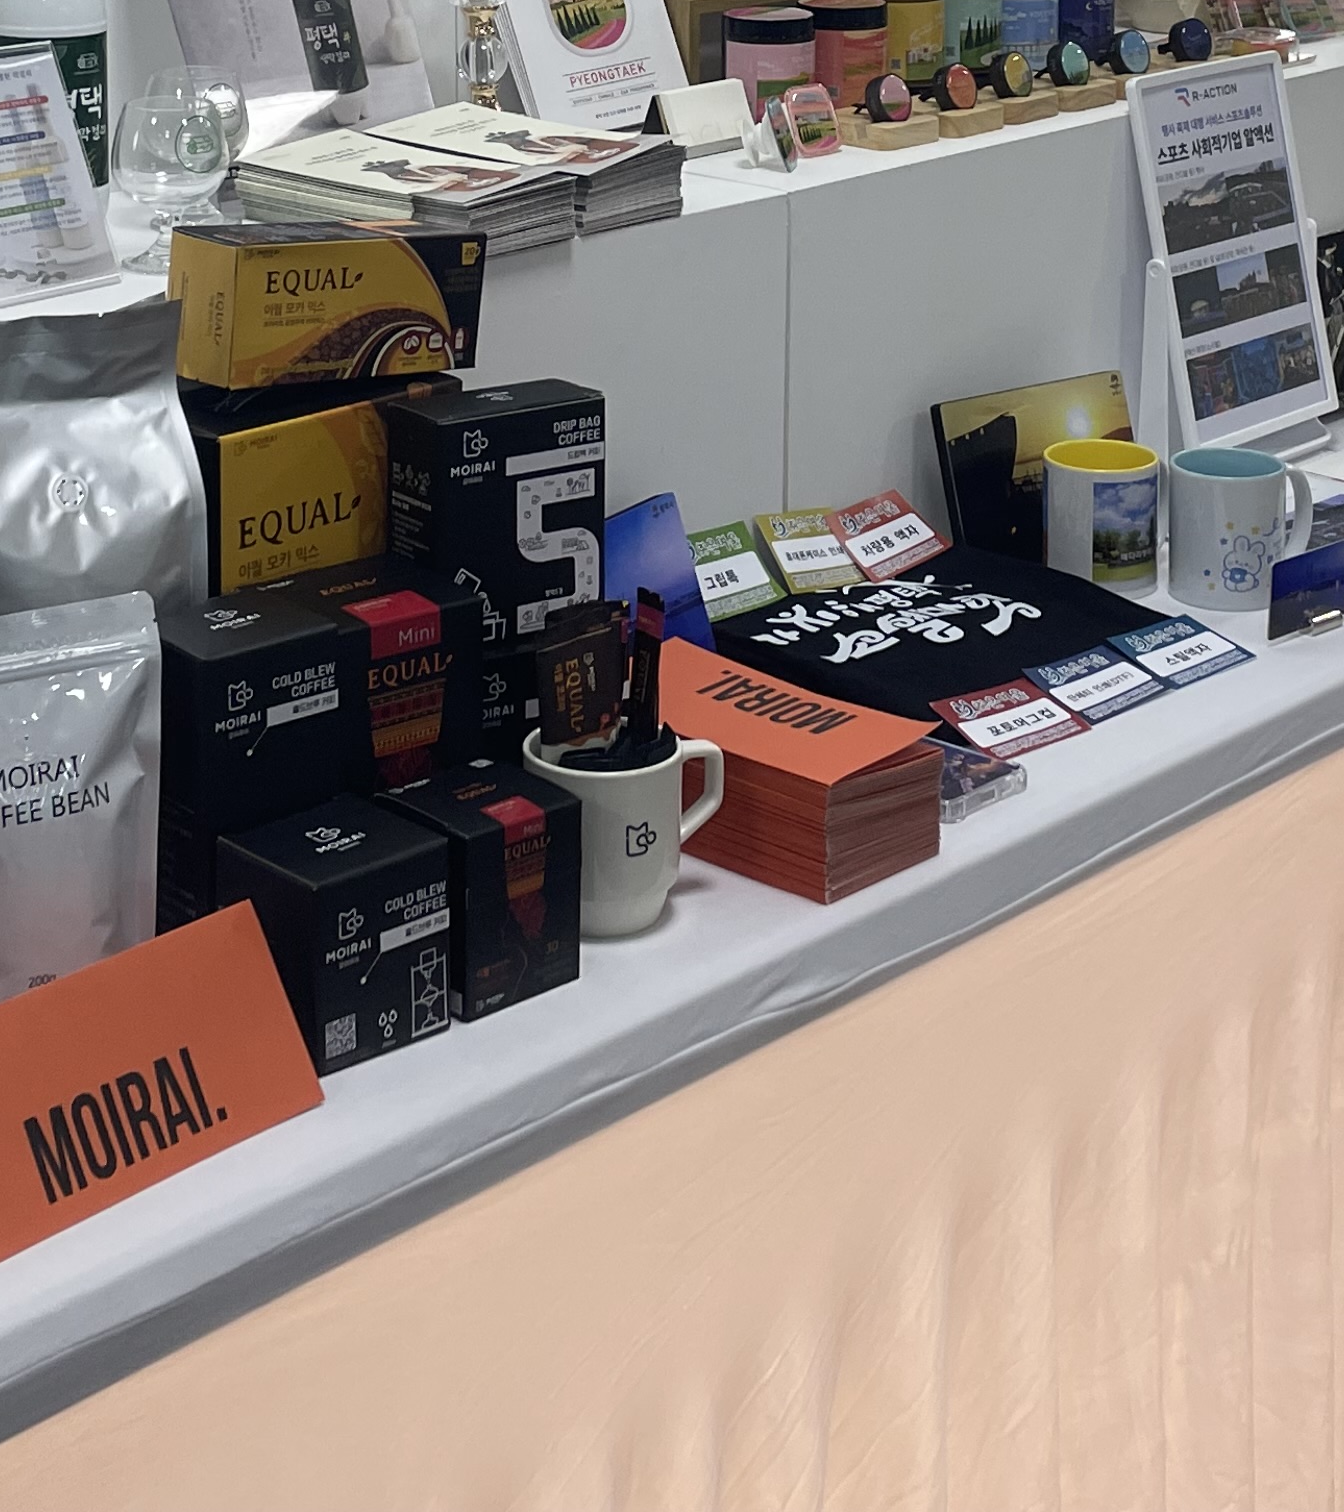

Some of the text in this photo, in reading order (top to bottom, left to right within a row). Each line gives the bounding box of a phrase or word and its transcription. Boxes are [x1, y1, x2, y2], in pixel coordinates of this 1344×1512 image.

[305, 23, 340, 50] 평택
[569, 61, 647, 88] PYEONGTAEK
[65, 83, 103, 119] 택
[1192, 83, 1237, 101] R-ACTION
[1191, 129, 1242, 158] 사회적기업
[266, 267, 355, 297] EQUAL
[553, 415, 601, 434] DRIP BAG
[558, 428, 601, 446] COFFEE
[450, 460, 495, 478] MOIRAI
[238, 492, 352, 549] EQUAL
[397, 624, 436, 648] Mini
[272, 661, 336, 690] COLD BLEW
[367, 651, 447, 689] EQUAL
[291, 675, 336, 698] COFFEE
[215, 710, 261, 733] MOIRAI
[52, 782, 112, 820] BEAN
[504, 834, 546, 861] EQUAL
[384, 880, 447, 914] COLD BLEW
[403, 895, 447, 920] COFFEE
[325, 937, 372, 965] MOIRAI
[23, 1046, 229, 1205] MOIRAI.
